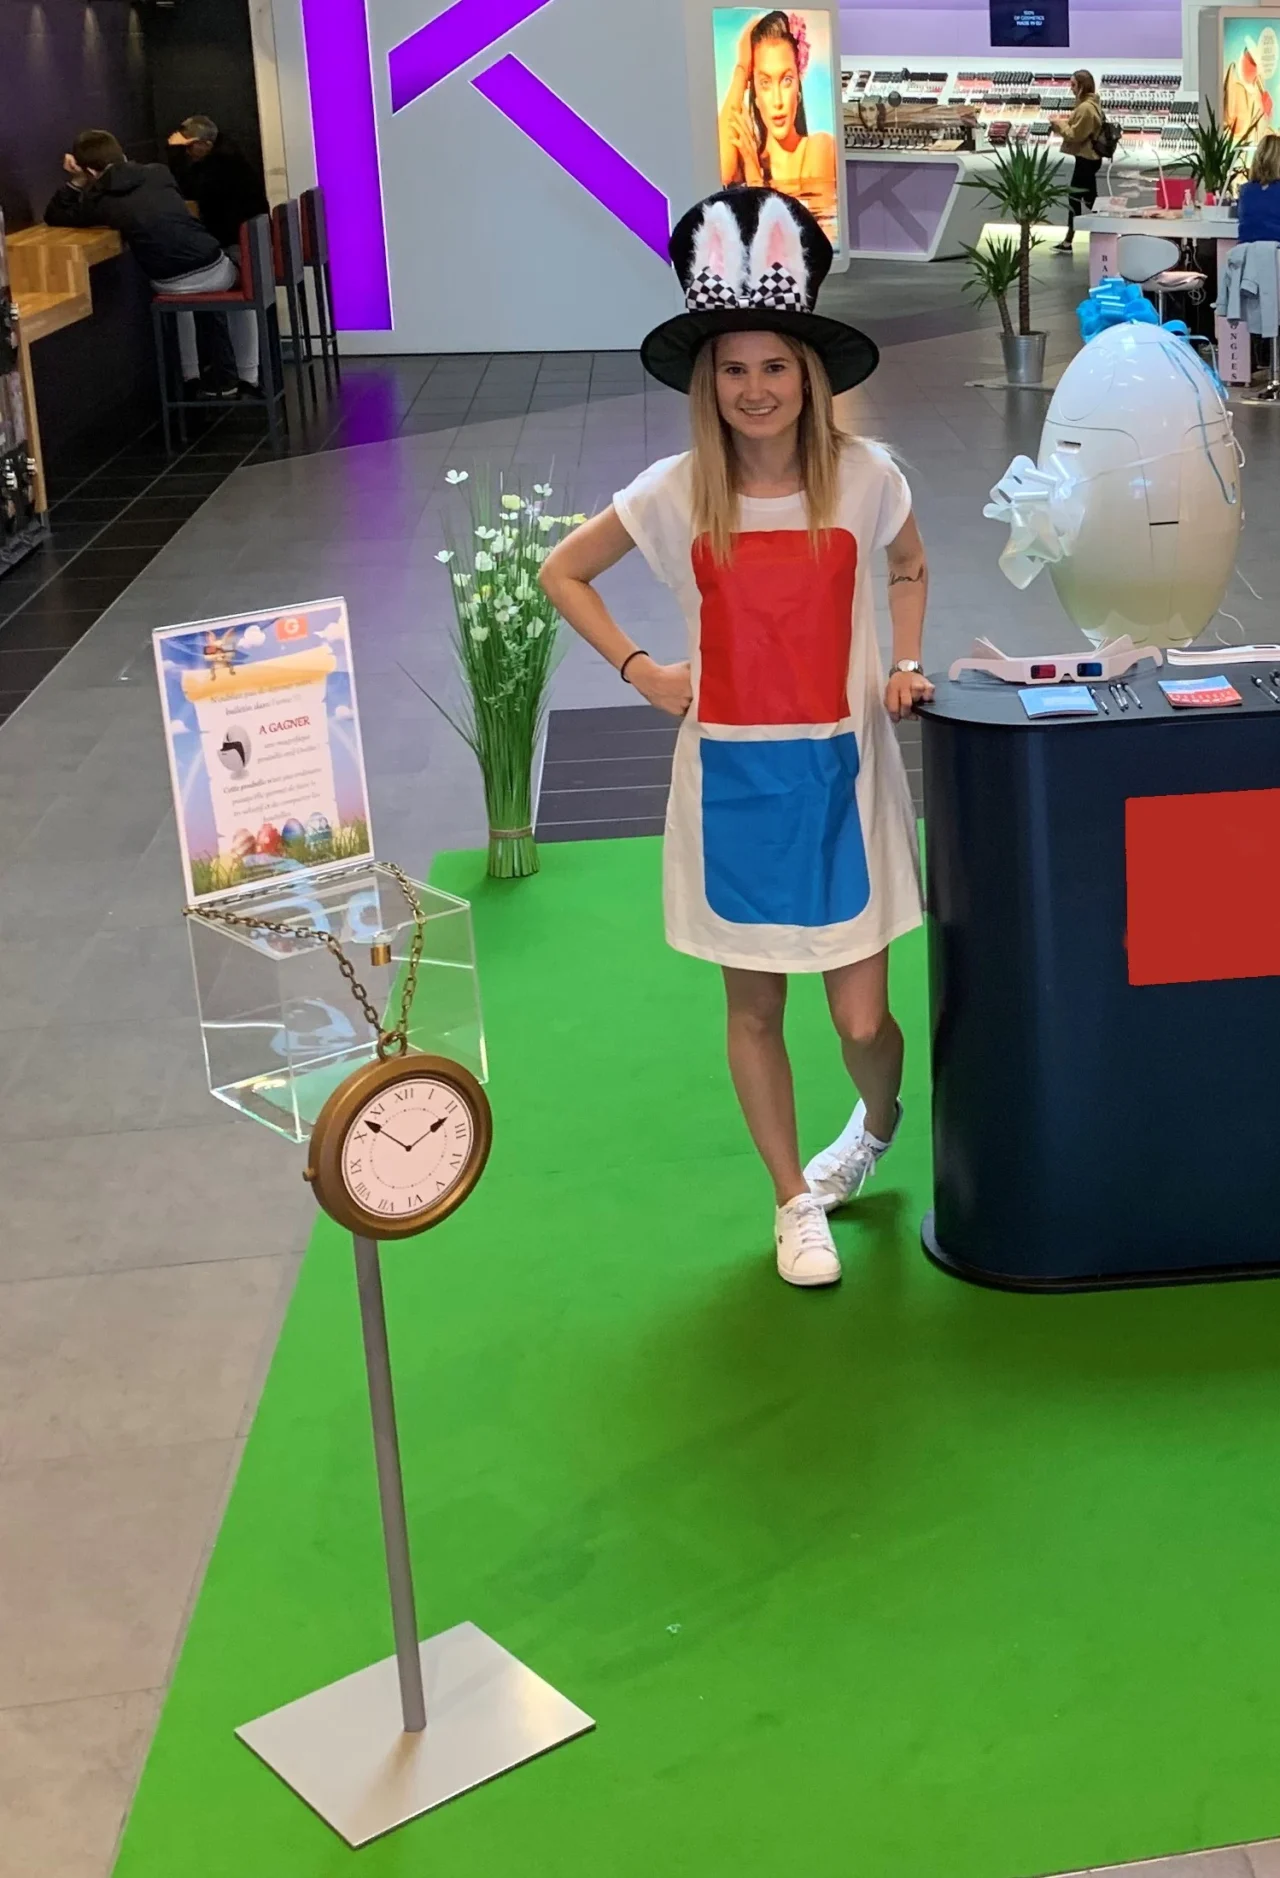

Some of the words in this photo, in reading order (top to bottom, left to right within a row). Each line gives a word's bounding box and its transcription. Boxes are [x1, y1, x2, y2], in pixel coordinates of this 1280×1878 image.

[258, 725, 267, 735] A
[268, 716, 311, 734] GAGNER
[444, 1099, 458, 1114] II
[353, 1130, 368, 1144] X
[454, 1122, 467, 1140] III
[435, 1180, 446, 1192] V
